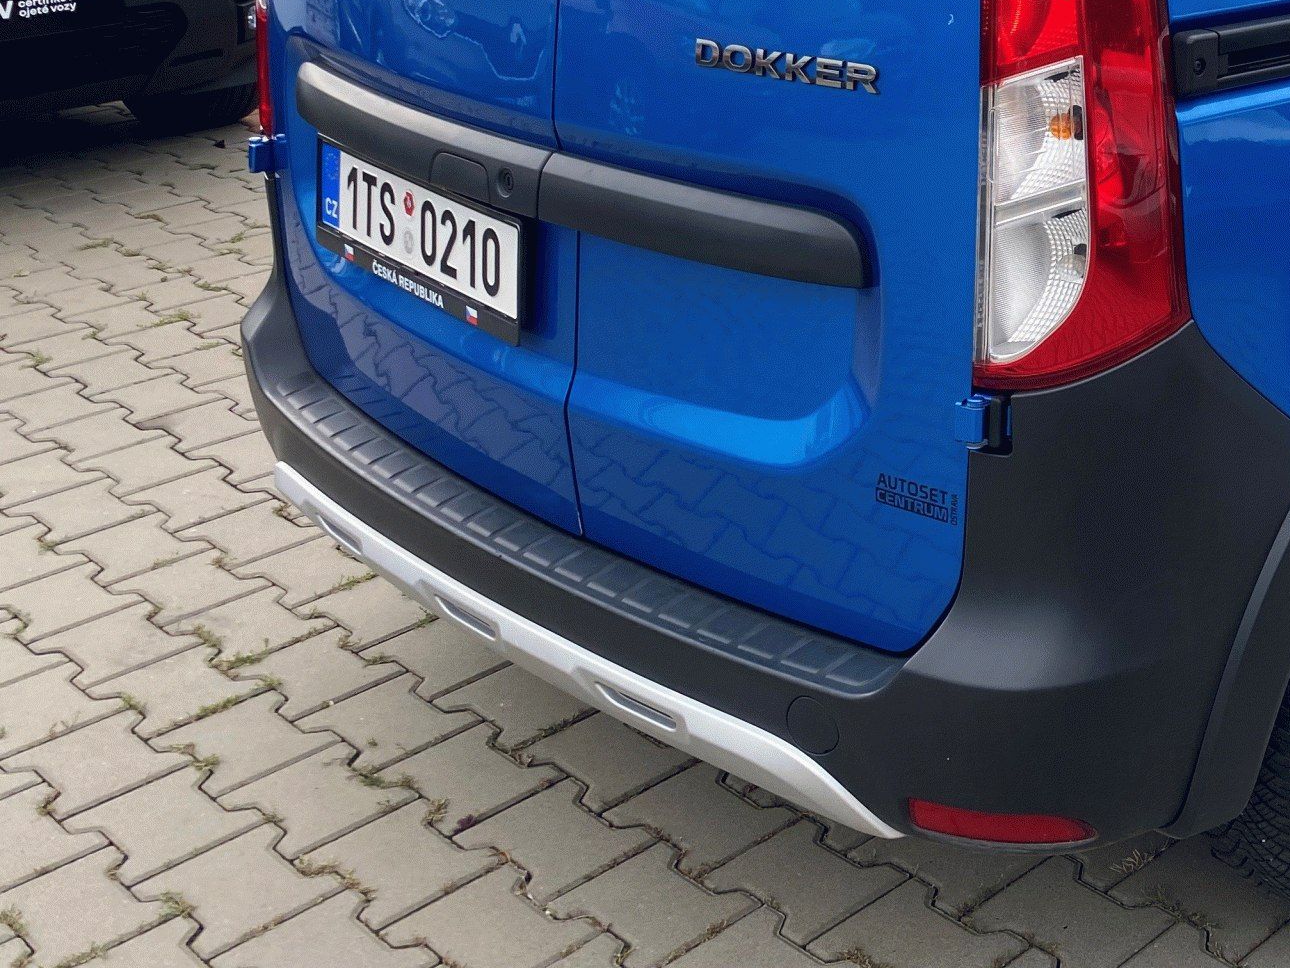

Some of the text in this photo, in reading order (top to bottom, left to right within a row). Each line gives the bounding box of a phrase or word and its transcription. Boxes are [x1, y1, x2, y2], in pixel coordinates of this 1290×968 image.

[18, 5, 49, 18] ojeté
[49, 2, 77, 13] vozy
[695, 37, 880, 95] DOKKER
[325, 197, 338, 219] CZ
[347, 166, 501, 297] 1TS 0210
[372, 259, 444, 309] ČESKÁ REPUBLIKA
[876, 488, 948, 522] CENTRUM
[877, 473, 948, 505] AUTOSET
